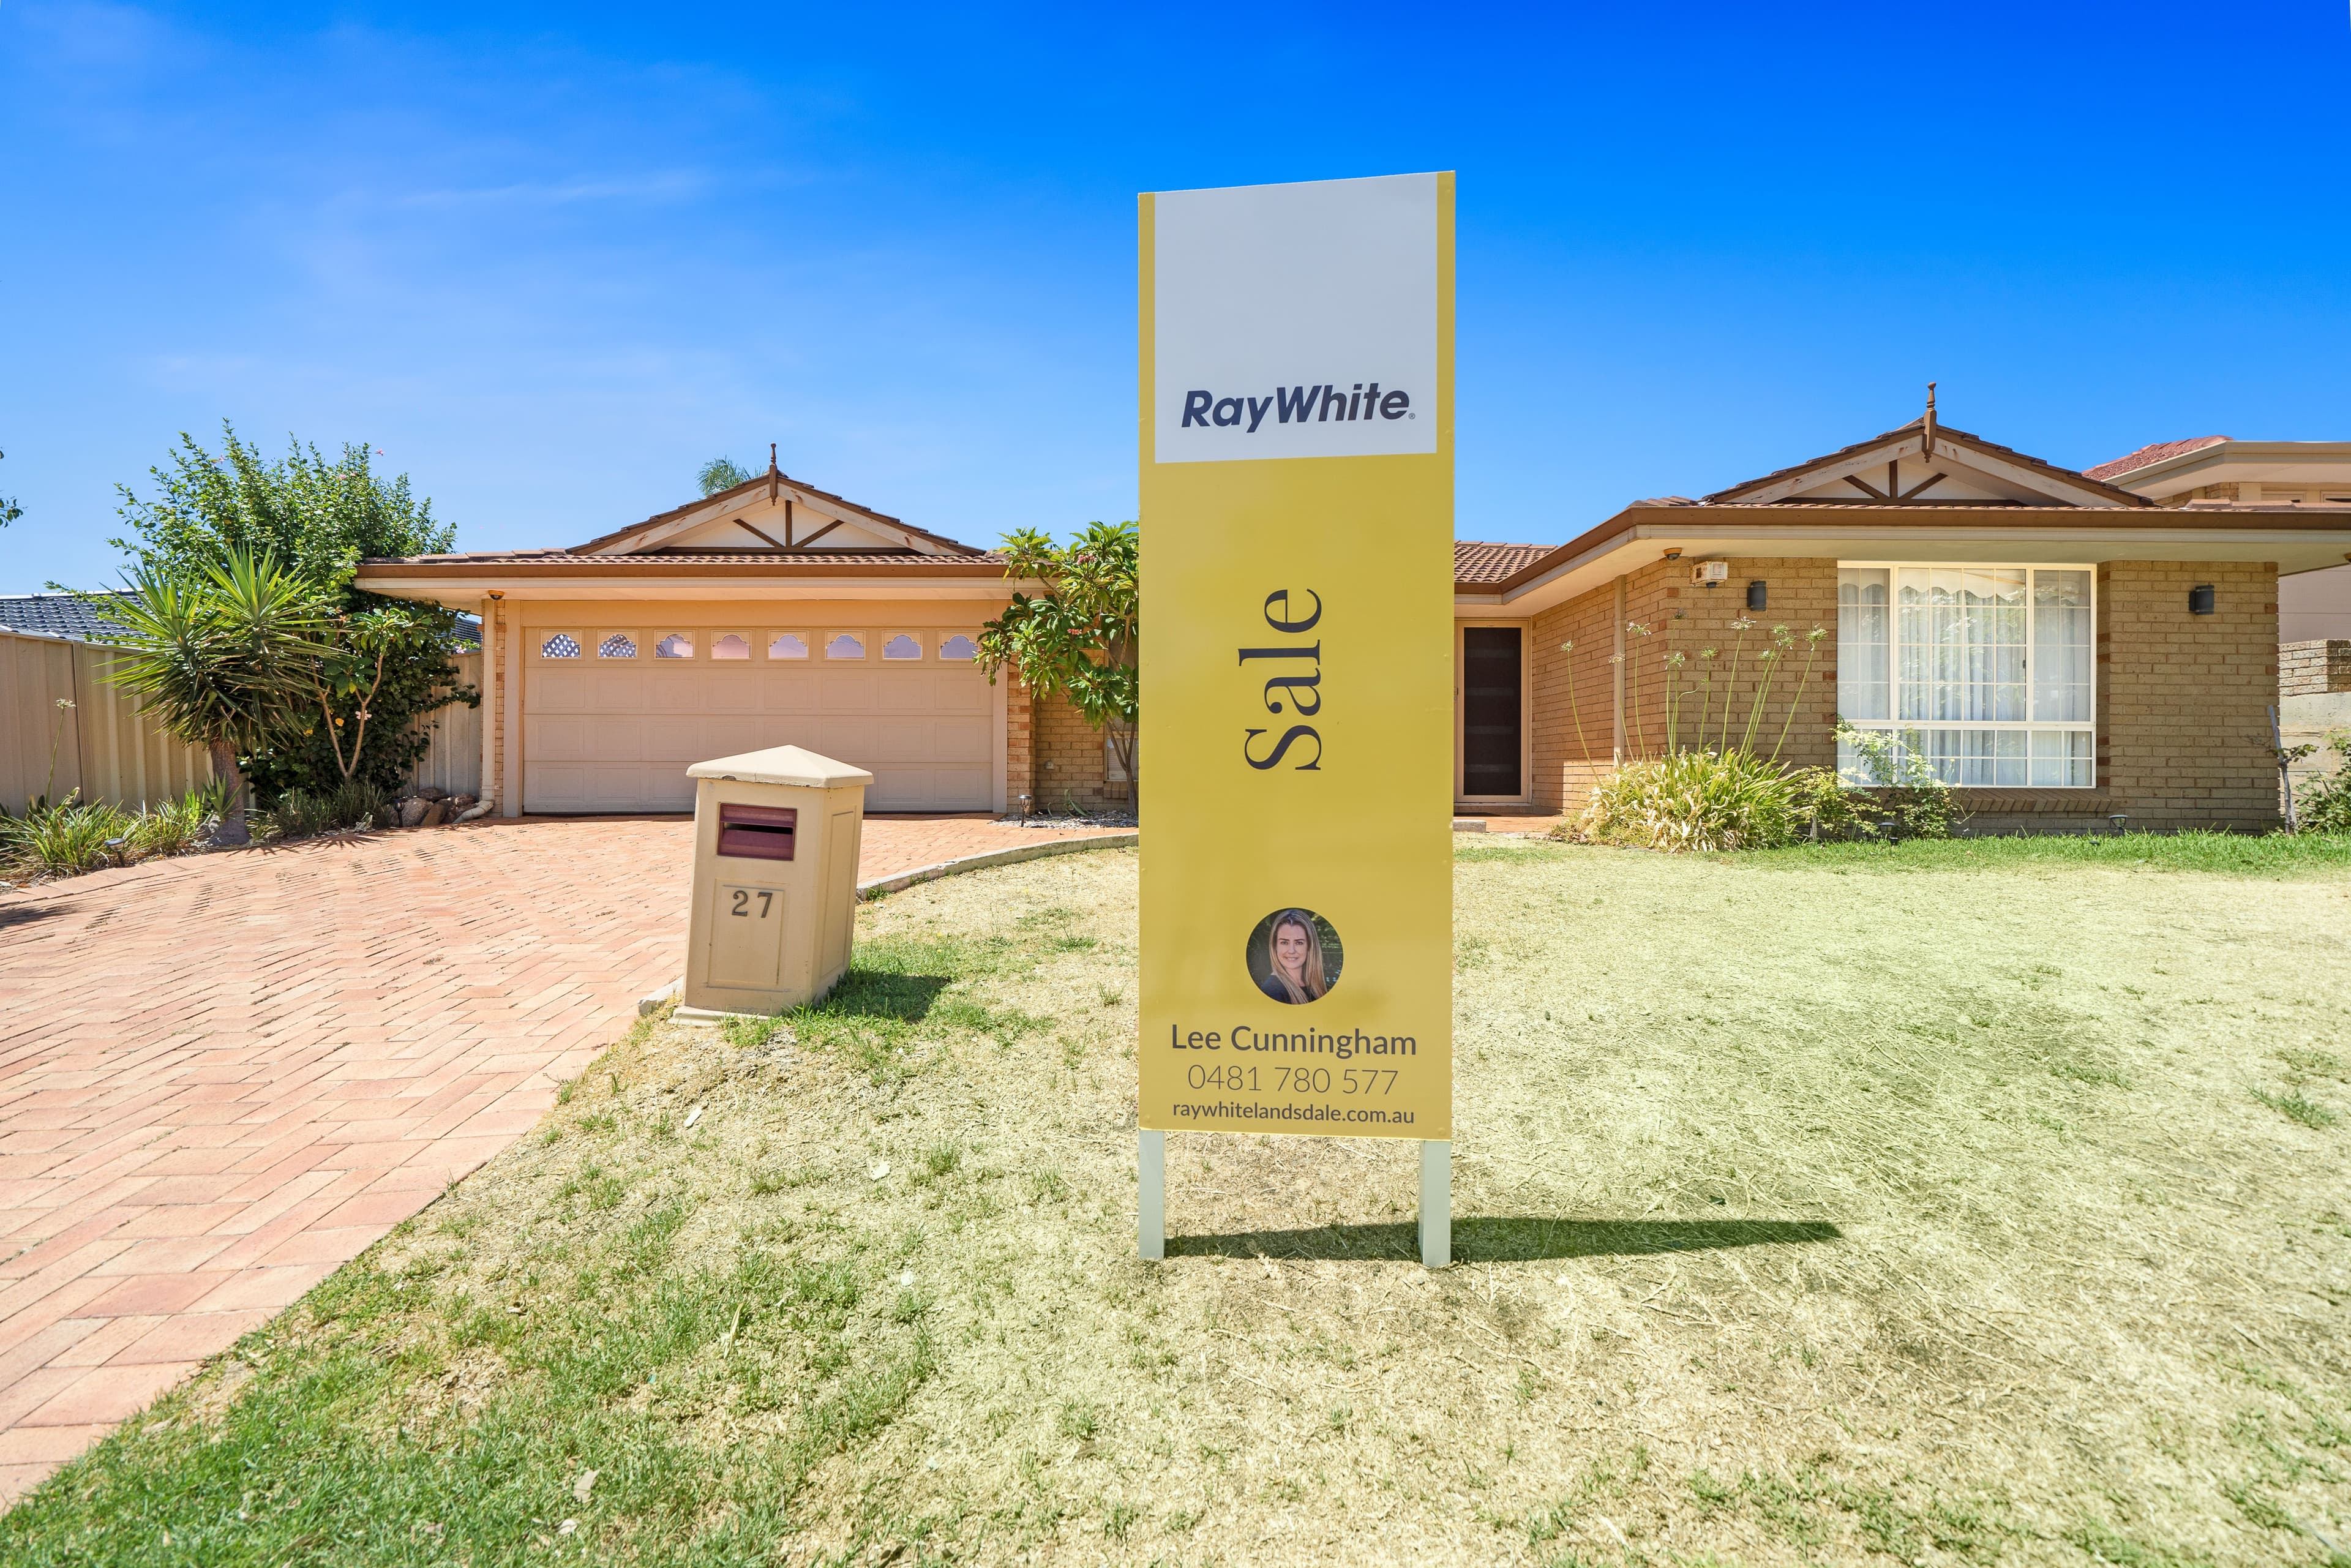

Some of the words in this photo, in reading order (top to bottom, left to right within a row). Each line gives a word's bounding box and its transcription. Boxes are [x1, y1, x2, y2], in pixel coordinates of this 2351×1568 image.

[1237, 588, 1322, 770] Sale
[732, 890, 773, 918] 27
[1172, 1024, 1221, 1050] Lee
[1231, 1026, 1416, 1059] Cunningham
[1188, 1065, 1262, 1092] 0481
[1274, 1067, 1330, 1093] 780
[1343, 1069, 1398, 1095] 577
[1173, 1101, 1415, 1123] raywhitelandsdale.com.au
